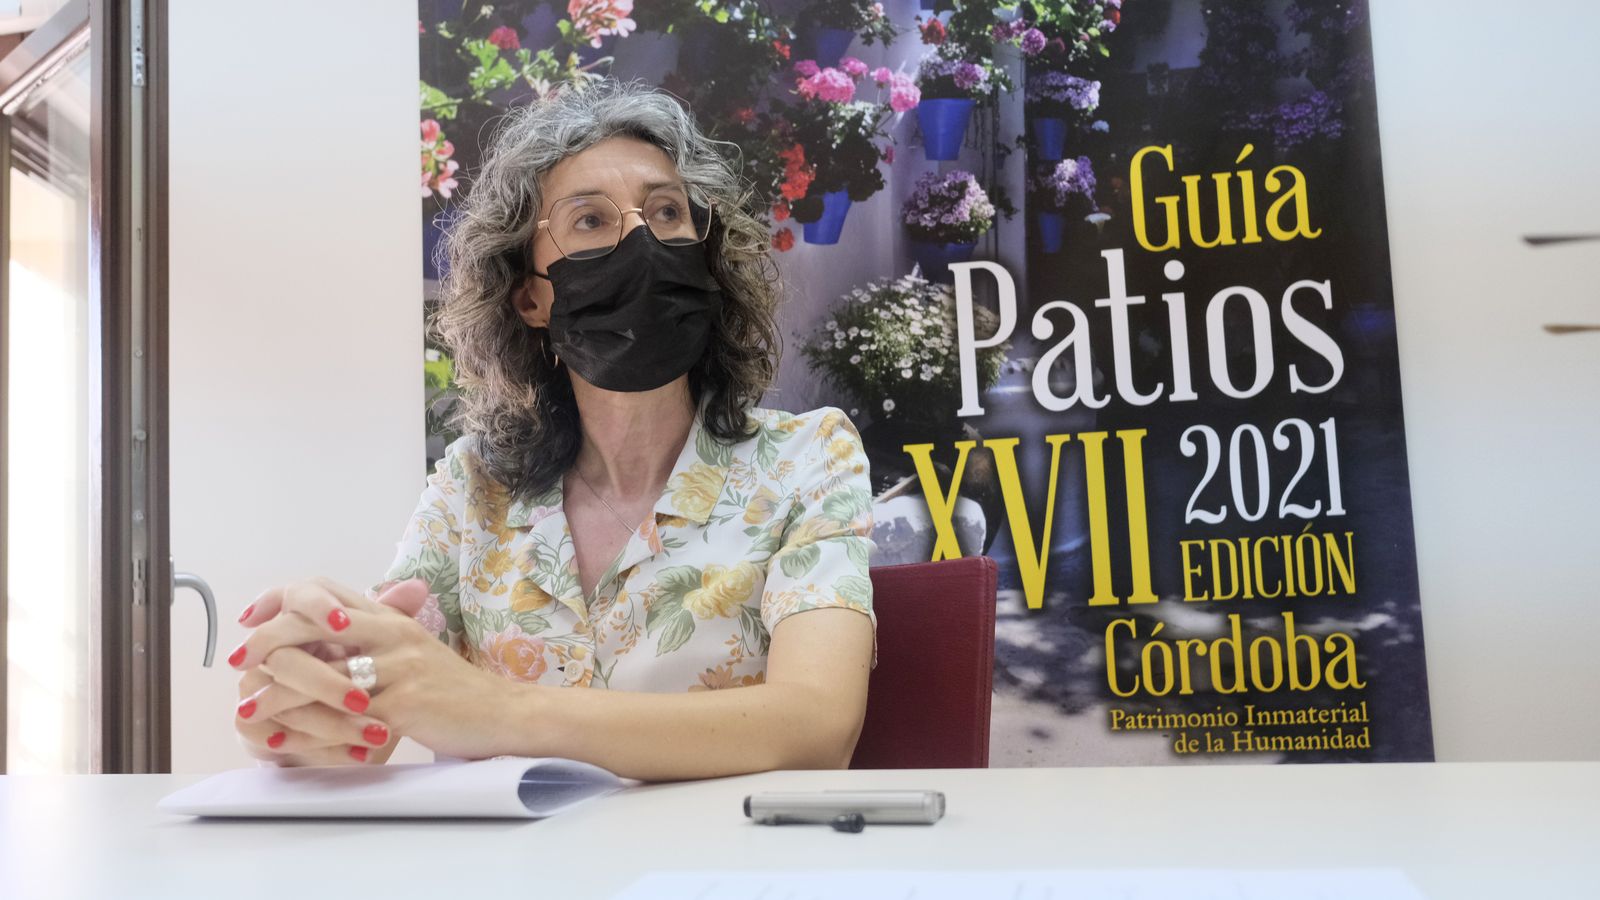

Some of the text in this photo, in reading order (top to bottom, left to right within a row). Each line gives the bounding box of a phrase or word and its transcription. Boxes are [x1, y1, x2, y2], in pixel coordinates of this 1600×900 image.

[1130, 143, 1322, 252] Guía
[947, 247, 1344, 417] Patios
[1179, 417, 1346, 524] 2021
[902, 429, 1159, 609] XVII
[1179, 522, 1356, 602] EDICIÓN
[1105, 612, 1366, 697] Córdoba
[1110, 701, 1369, 730] Patrimonio Inmaterial
[1174, 727, 1371, 753] de la Humanidad
